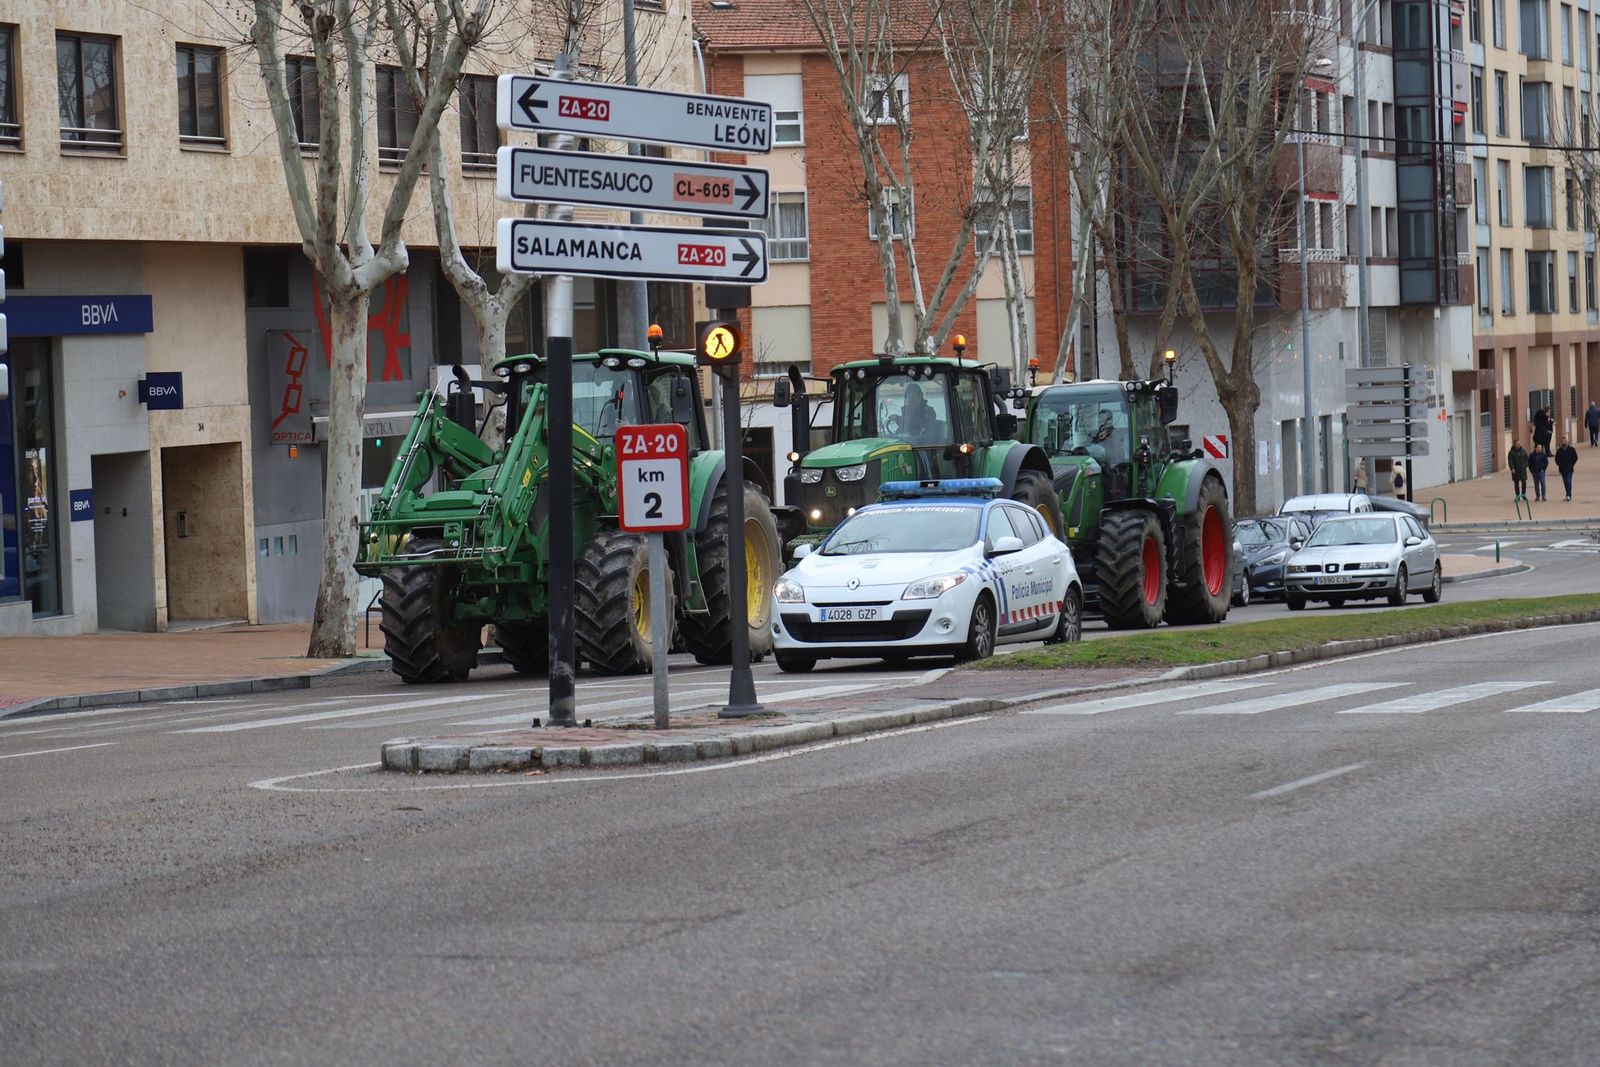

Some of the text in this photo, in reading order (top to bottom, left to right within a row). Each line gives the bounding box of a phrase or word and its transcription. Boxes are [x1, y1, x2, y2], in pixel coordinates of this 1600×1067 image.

[560, 98, 608, 118] ZA-20
[687, 101, 767, 122] BENAVENTE
[714, 123, 766, 146] LEÓN
[520, 164, 653, 194] FUENTESAUCO
[676, 180, 730, 199] CL-605
[517, 236, 642, 261] SALAMANCA
[679, 246, 724, 264] ZA-20
[81, 301, 119, 325] BBVA
[149, 385, 177, 396] BBVA
[272, 431, 311, 441] OPTICA
[622, 433, 678, 454] ZA-20
[638, 467, 665, 482] km
[73, 499, 90, 511] BBVA
[643, 492, 663, 519] 2
[1031, 576, 1053, 597] Municipal
[828, 608, 877, 621] 4028 GZP
